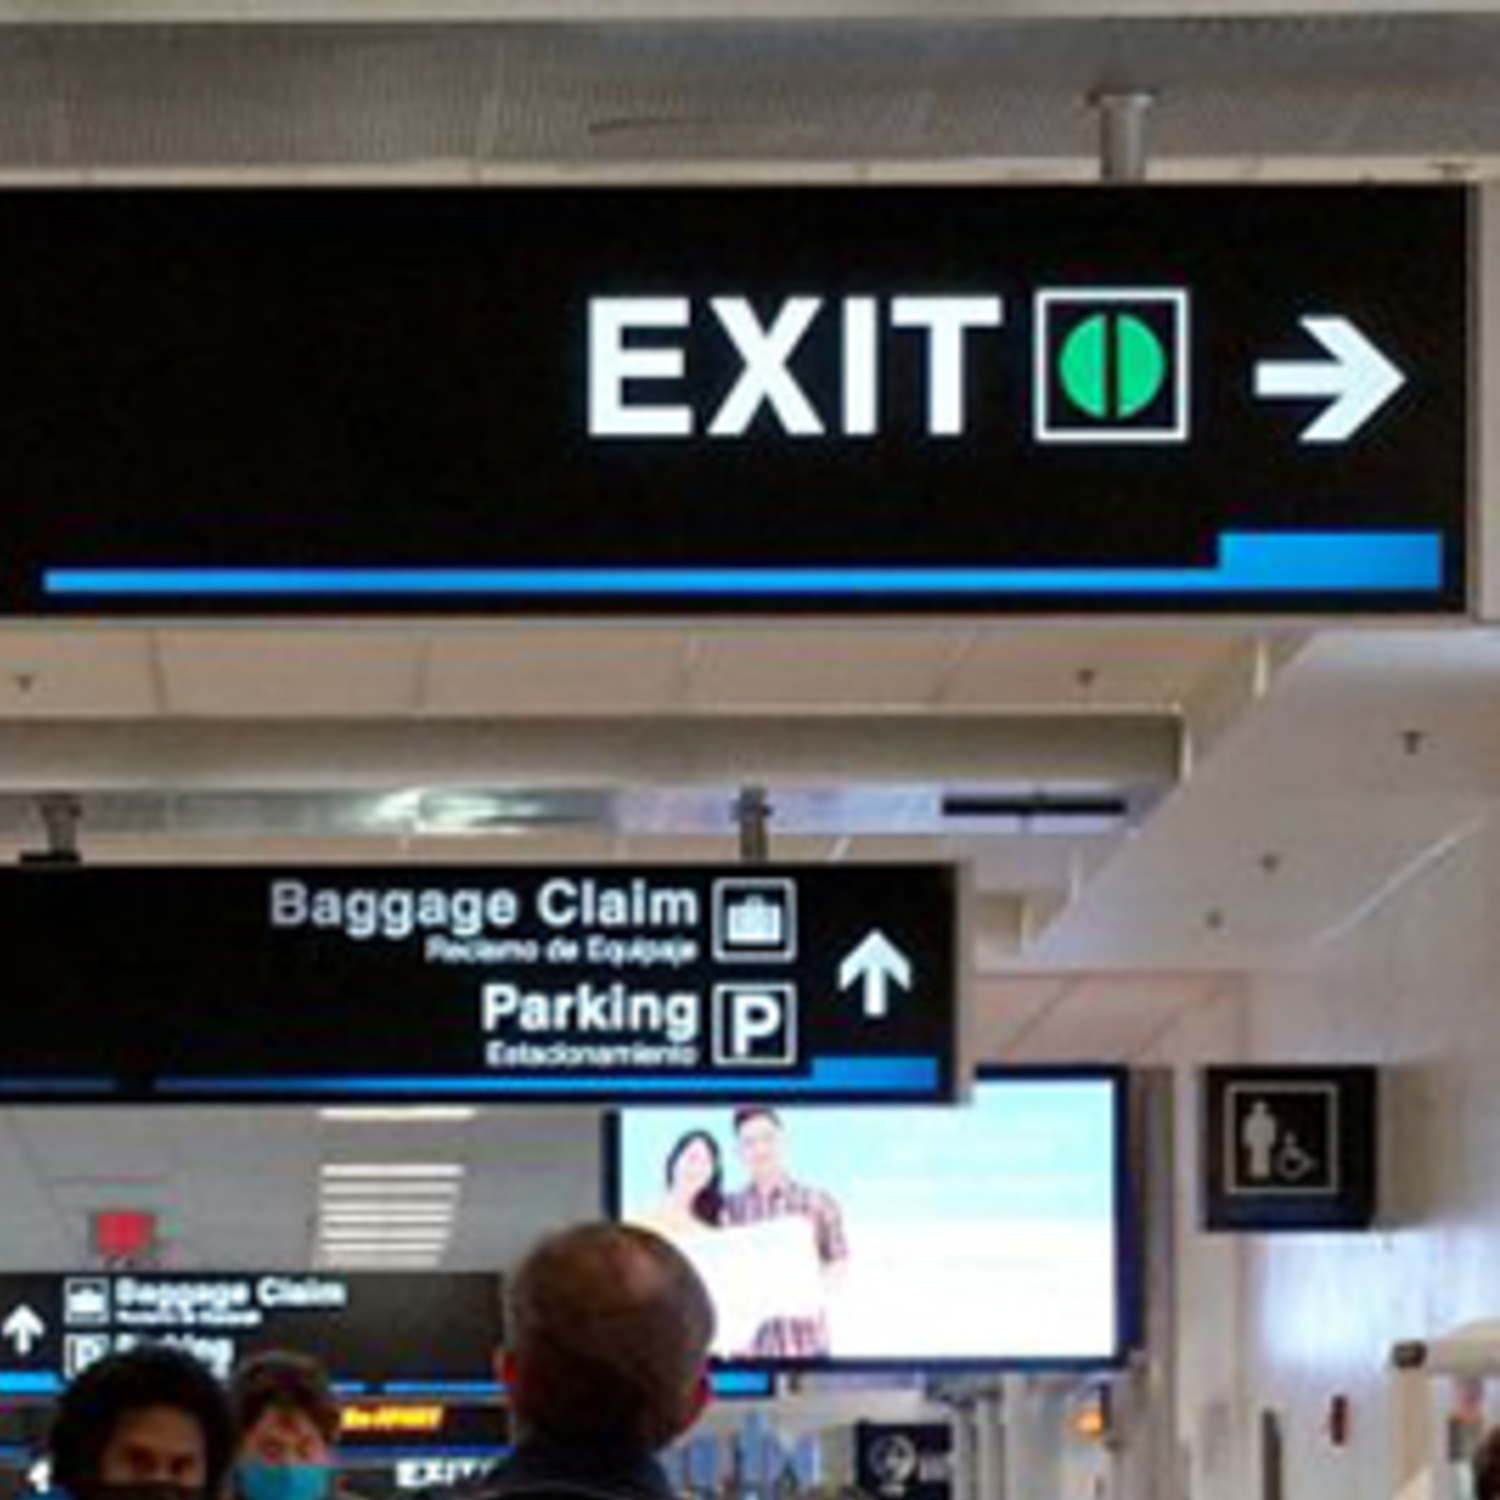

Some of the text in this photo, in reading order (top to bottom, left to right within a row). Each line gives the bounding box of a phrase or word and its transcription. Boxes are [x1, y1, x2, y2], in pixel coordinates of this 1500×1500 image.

[586, 296, 1003, 437] EXIT
[271, 878, 698, 935] Baggage Claim
[546, 937, 579, 961] de
[483, 983, 699, 1040] Parking
